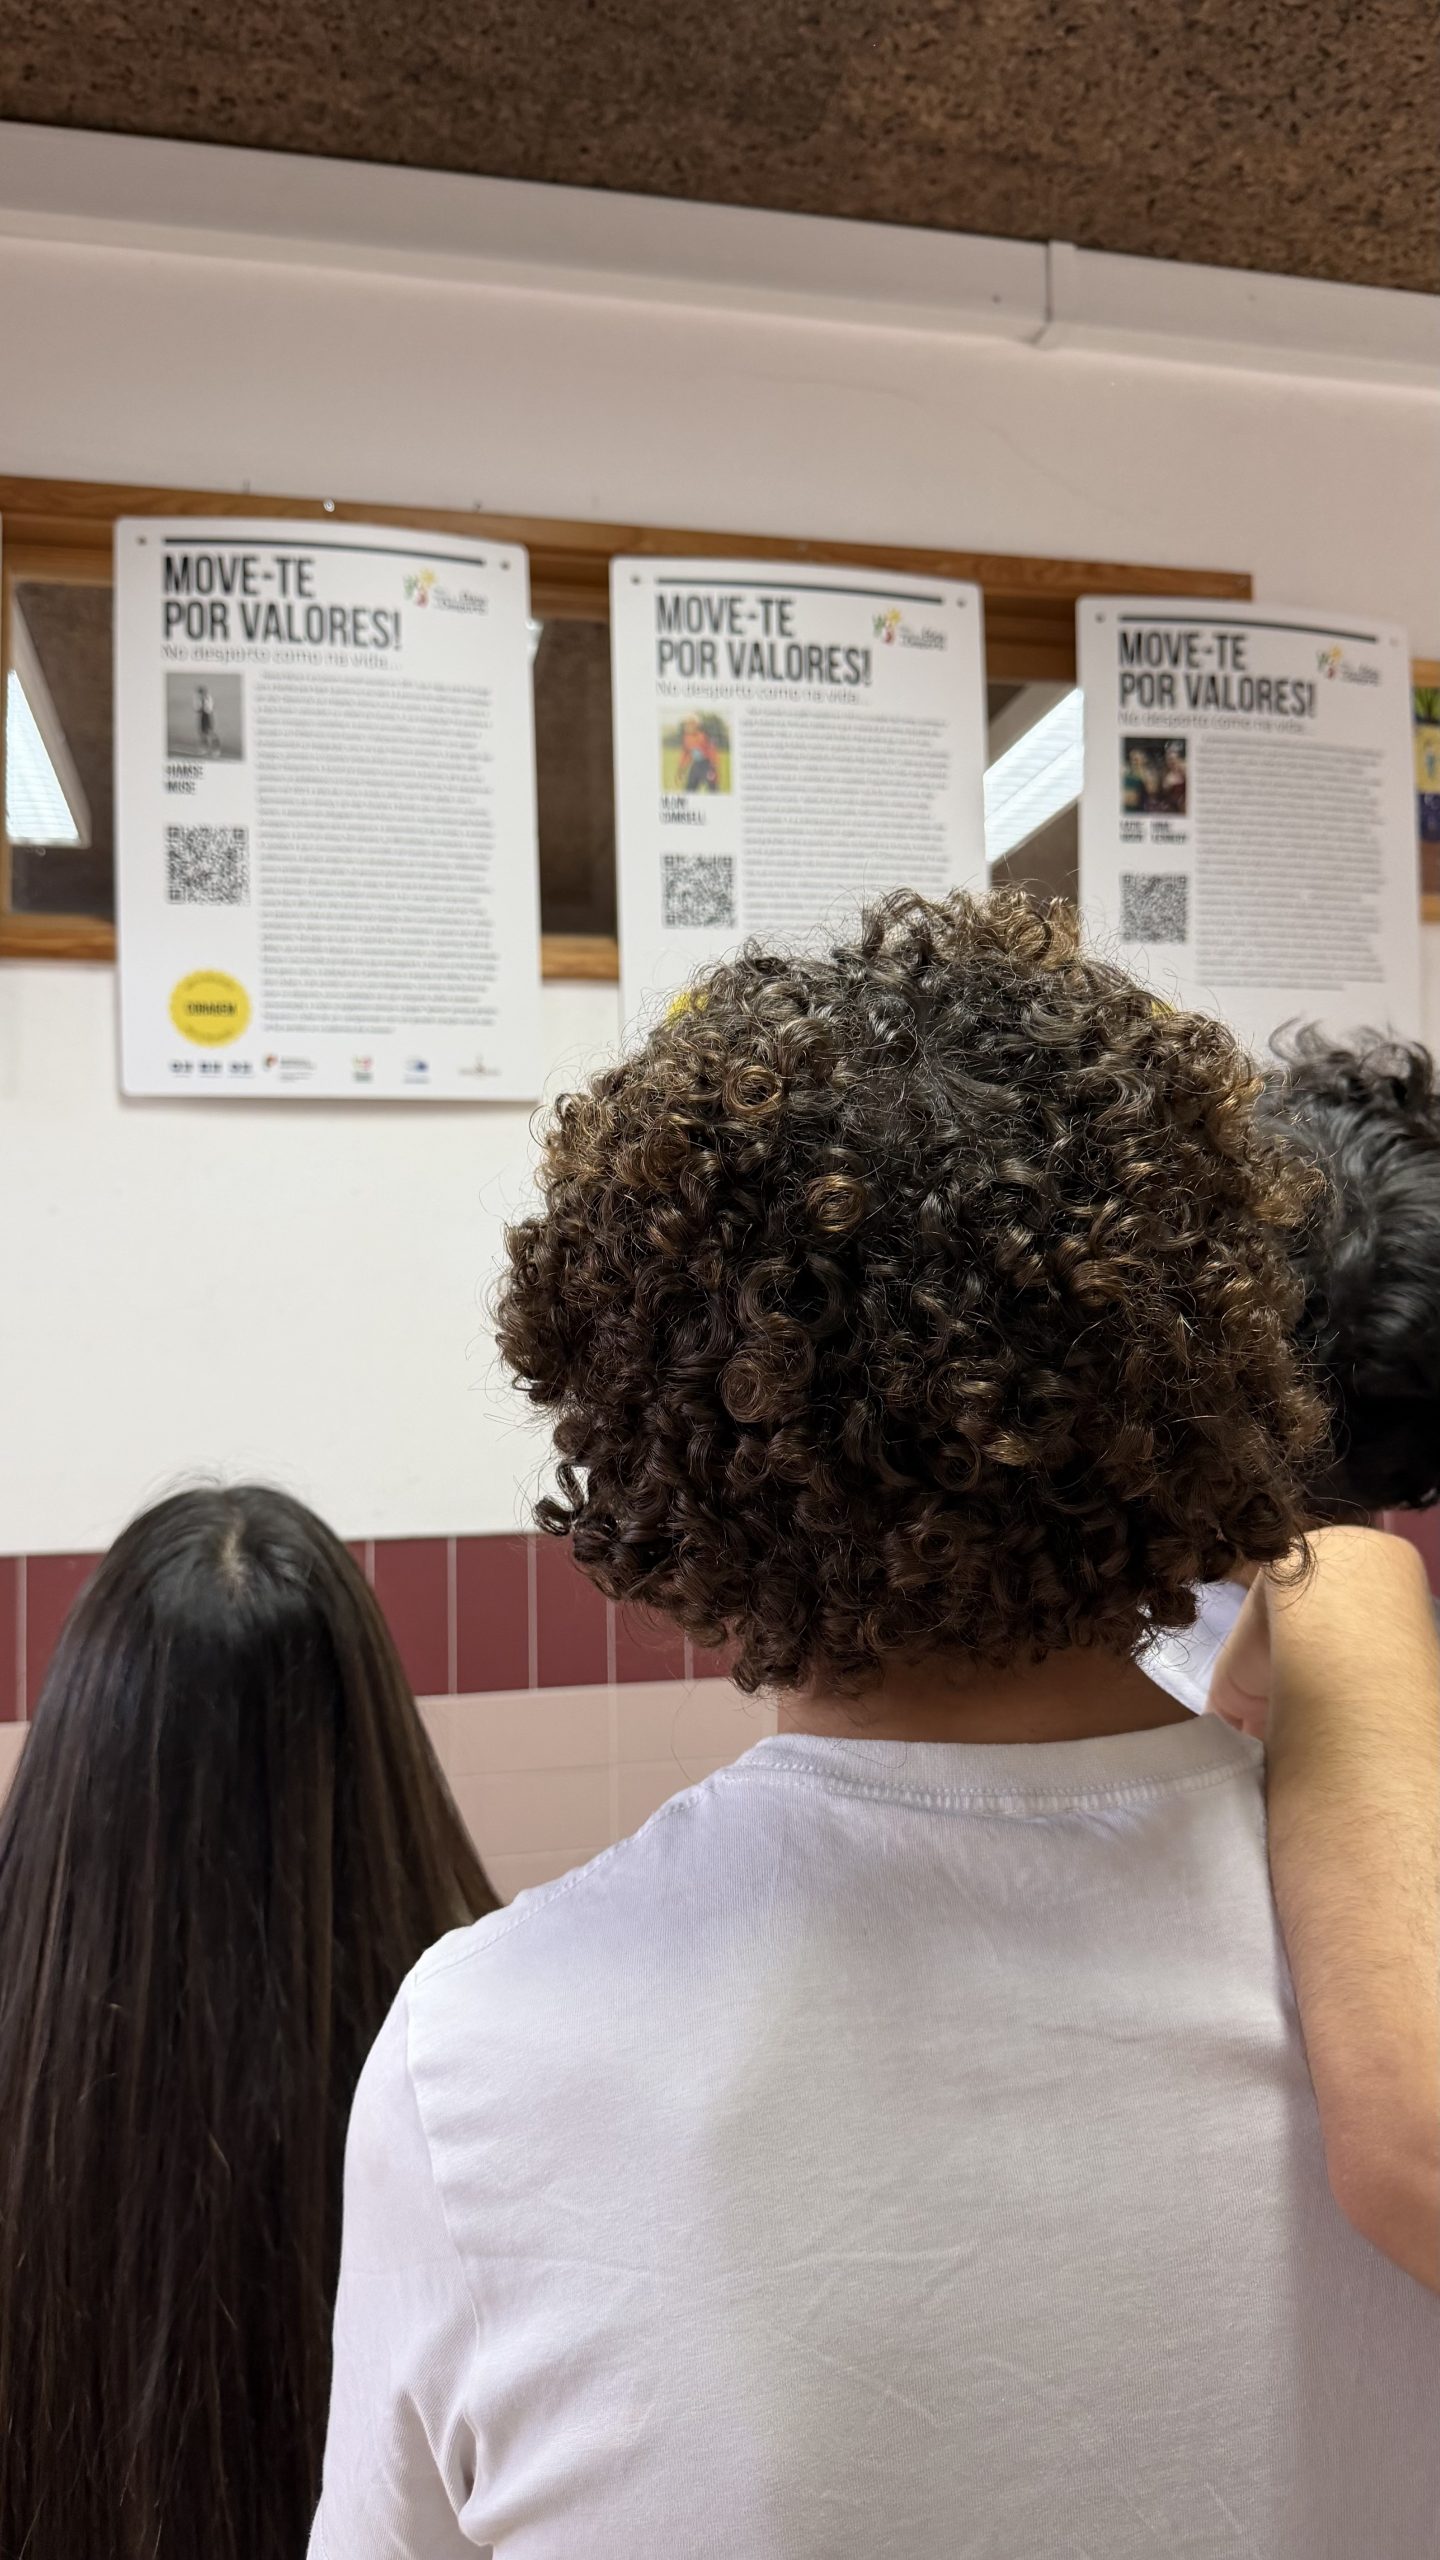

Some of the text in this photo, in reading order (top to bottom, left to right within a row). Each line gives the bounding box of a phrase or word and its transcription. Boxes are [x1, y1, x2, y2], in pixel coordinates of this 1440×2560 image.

[164, 553, 315, 599] MOVE-TE
[164, 600, 403, 652] POR VALORES!
[656, 593, 795, 637] MOVE-TE
[657, 638, 873, 687] POR VALORES!
[1120, 631, 1246, 671] MOVE-TE
[1120, 672, 1316, 719] POR VALORES!
